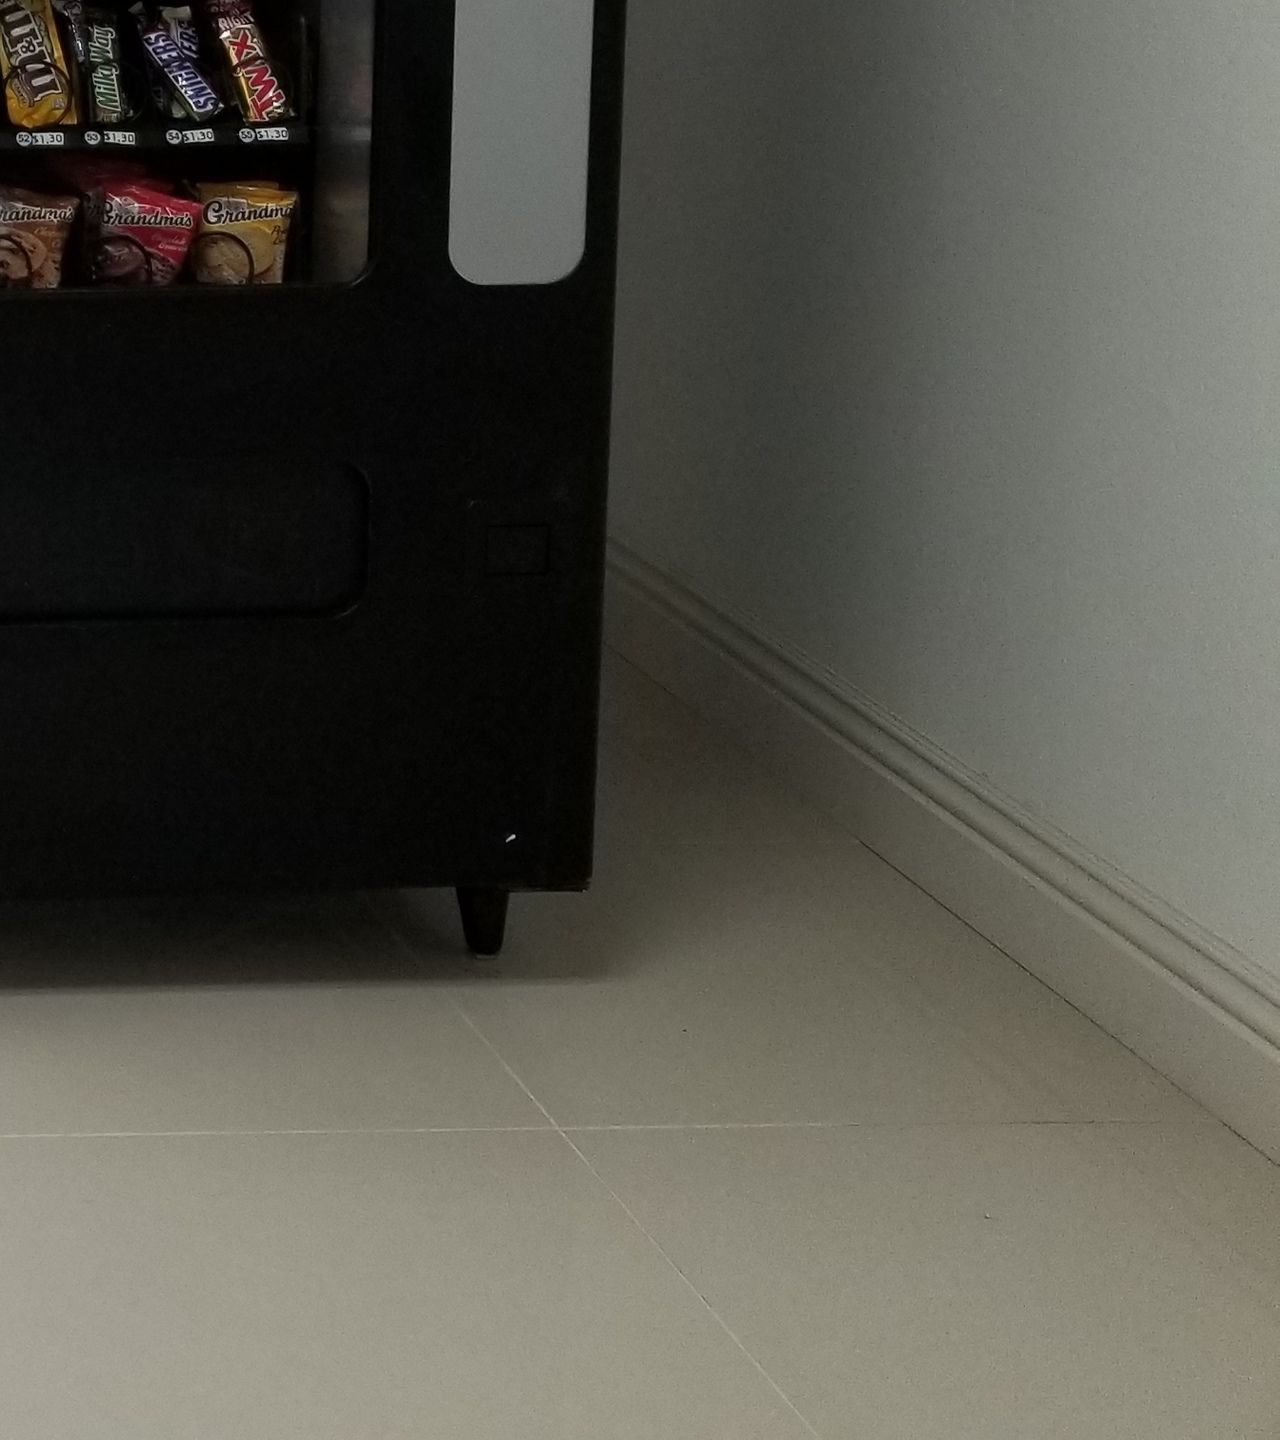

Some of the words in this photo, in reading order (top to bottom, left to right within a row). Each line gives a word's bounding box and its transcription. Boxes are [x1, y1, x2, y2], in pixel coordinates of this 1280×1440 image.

[88, 23, 117, 63] Way
[92, 62, 122, 112] Milky
[33, 134, 63, 143] $1.30
[105, 133, 135, 144] $1.30
[184, 131, 213, 141] $1.30
[258, 129, 288, 139] $1.30
